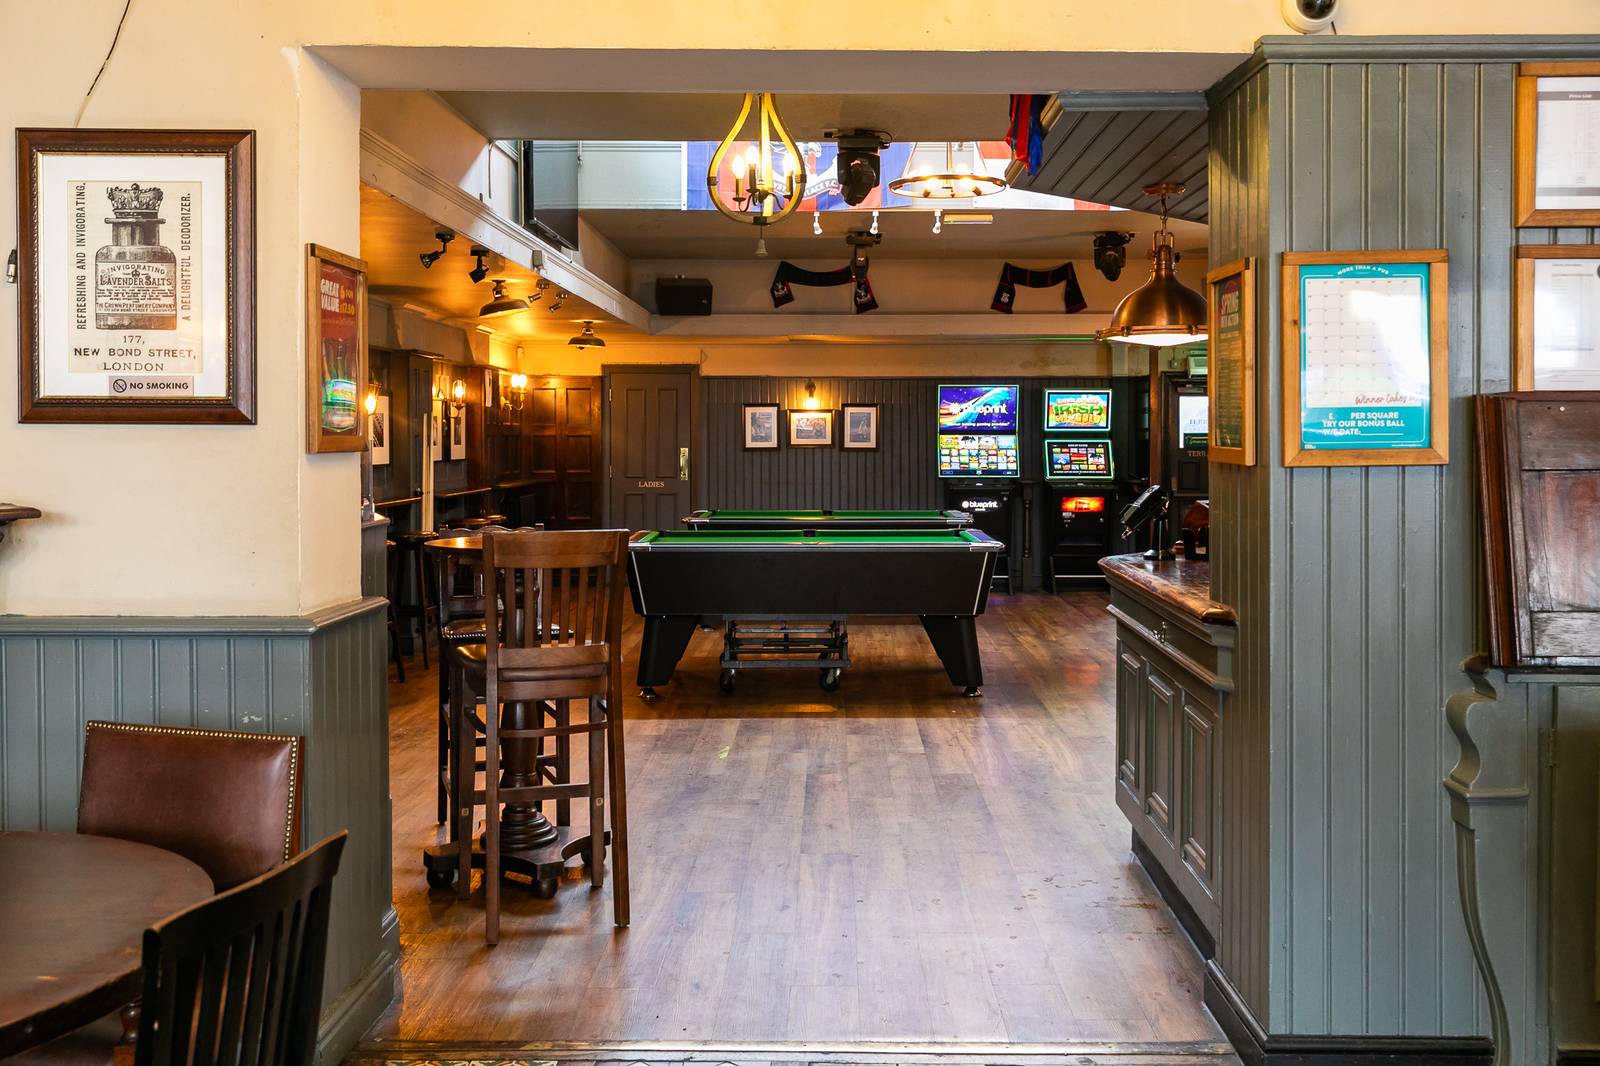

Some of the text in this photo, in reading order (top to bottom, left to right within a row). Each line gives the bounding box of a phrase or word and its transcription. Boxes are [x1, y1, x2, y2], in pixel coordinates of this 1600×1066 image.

[180, 193, 191, 251] DEODORIZER.
[76, 252, 86, 270] AND
[107, 264, 165, 275] INVIGORATING
[1338, 266, 1354, 275] MORE
[100, 274, 172, 286] LAVENDER SALTS
[181, 256, 191, 310] DELIGHTFUL
[320, 278, 340, 298] GREAT
[76, 275, 87, 330] REFRESHING
[321, 294, 340, 312] VALUE
[124, 336, 145, 344] 177,
[74, 348, 196, 359] NEW BOND STREET,
[1367, 412, 1399, 420] SQUARE
[970, 500, 998, 508] blueprint
